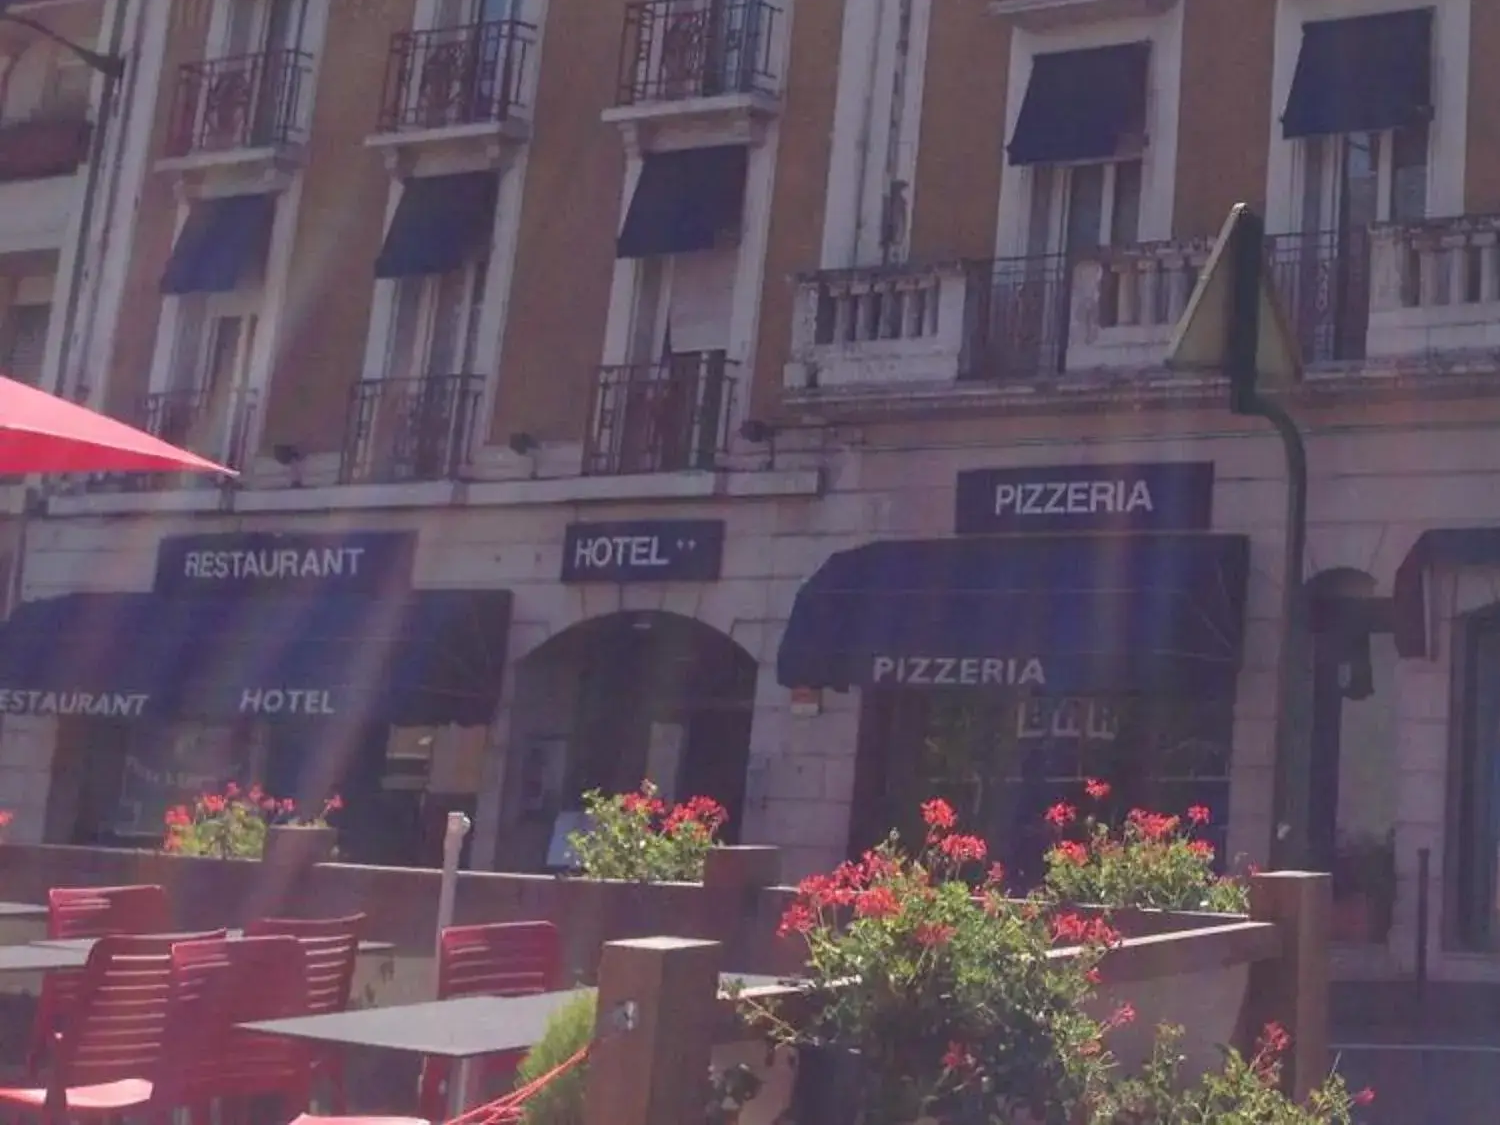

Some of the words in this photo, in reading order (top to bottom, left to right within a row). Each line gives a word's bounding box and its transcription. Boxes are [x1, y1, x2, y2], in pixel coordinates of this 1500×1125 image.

[995, 479, 1154, 516] PIZZERIA
[184, 547, 365, 580] RESTAURANT
[573, 536, 669, 567] HOTEL
[871, 656, 1046, 685] PIZZERIA
[0, 687, 150, 718] ESTAURANT
[240, 686, 337, 715] HOTEL
